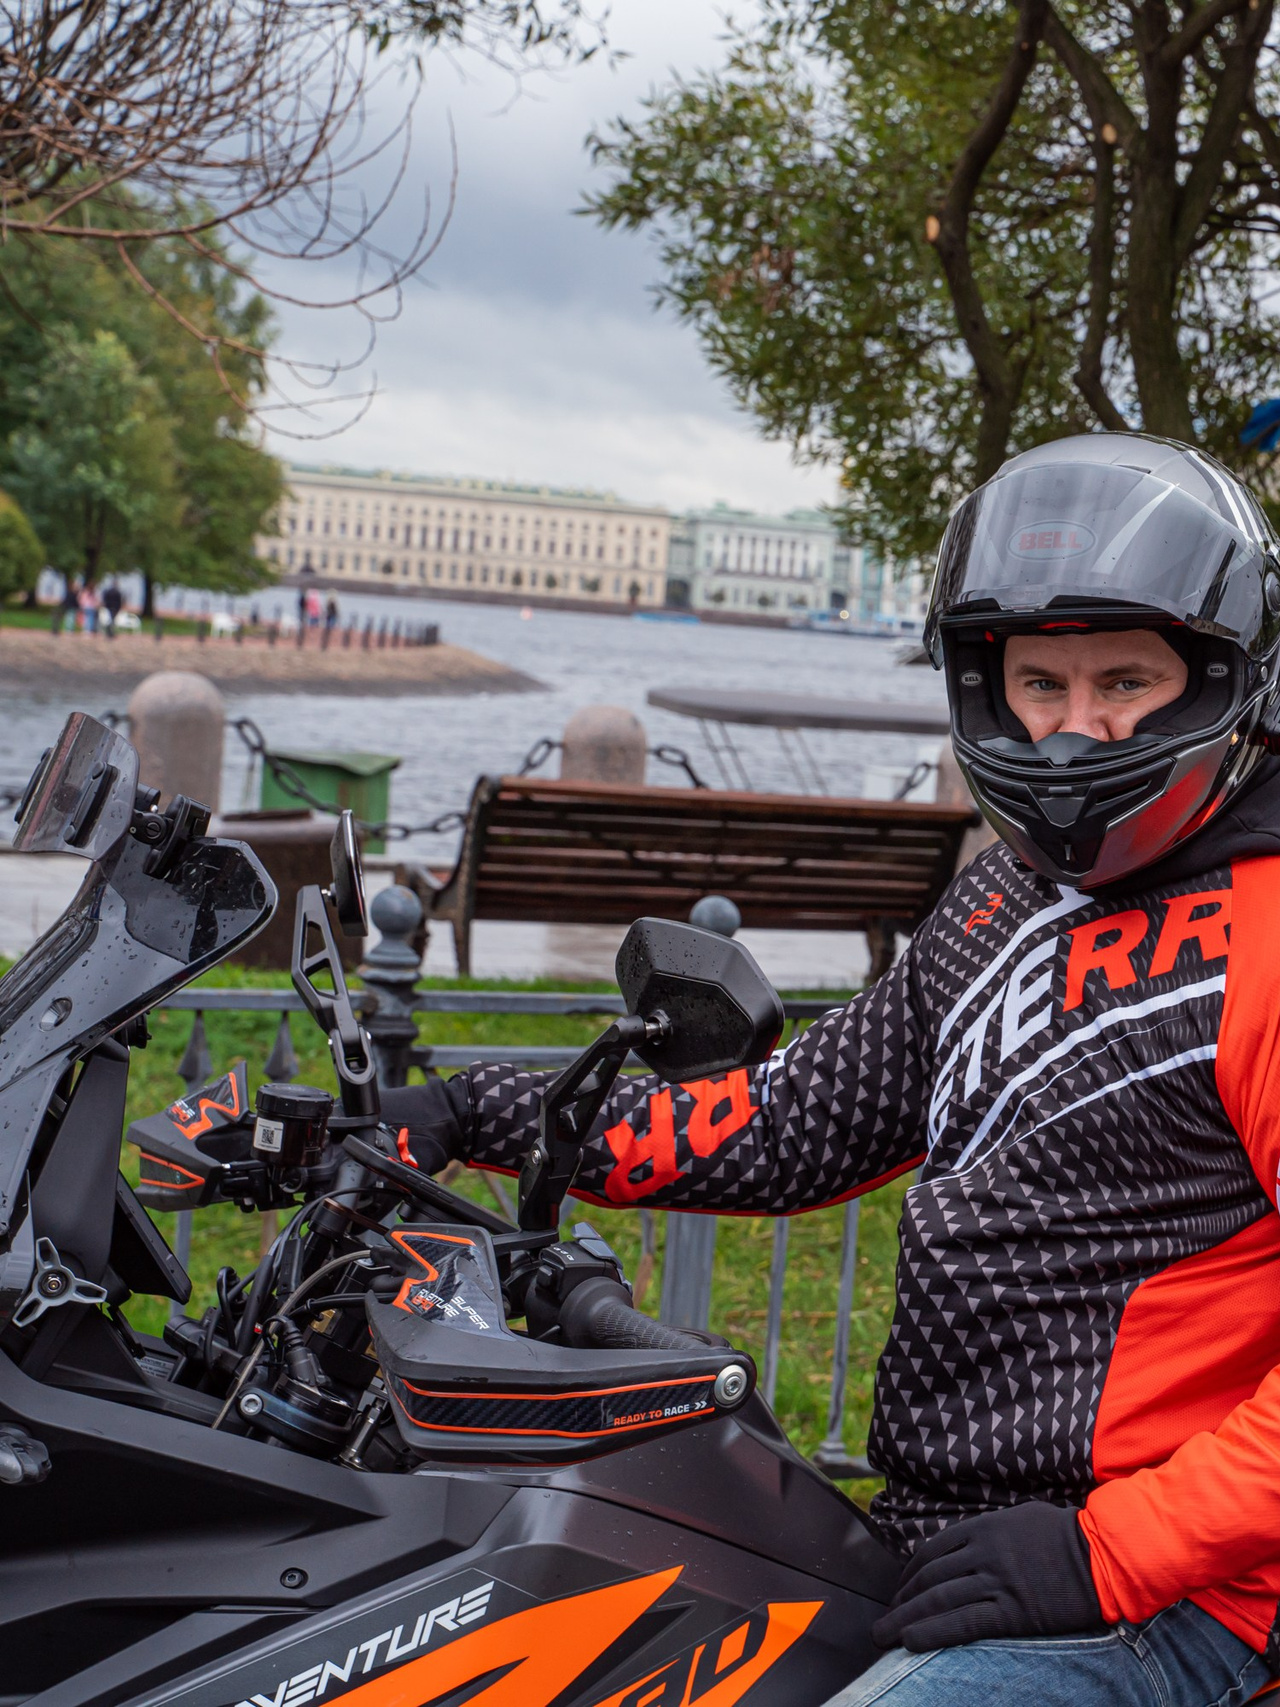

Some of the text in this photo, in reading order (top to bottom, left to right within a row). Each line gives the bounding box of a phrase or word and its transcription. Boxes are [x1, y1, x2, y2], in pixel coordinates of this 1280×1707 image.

[1019, 531, 1083, 551] BELL
[417, 1288, 460, 1318] ADVENTURE
[450, 1295, 490, 1330] SUPER
[613, 1404, 690, 1427] READY TO RACE
[234, 1580, 495, 1707] VENTURE
